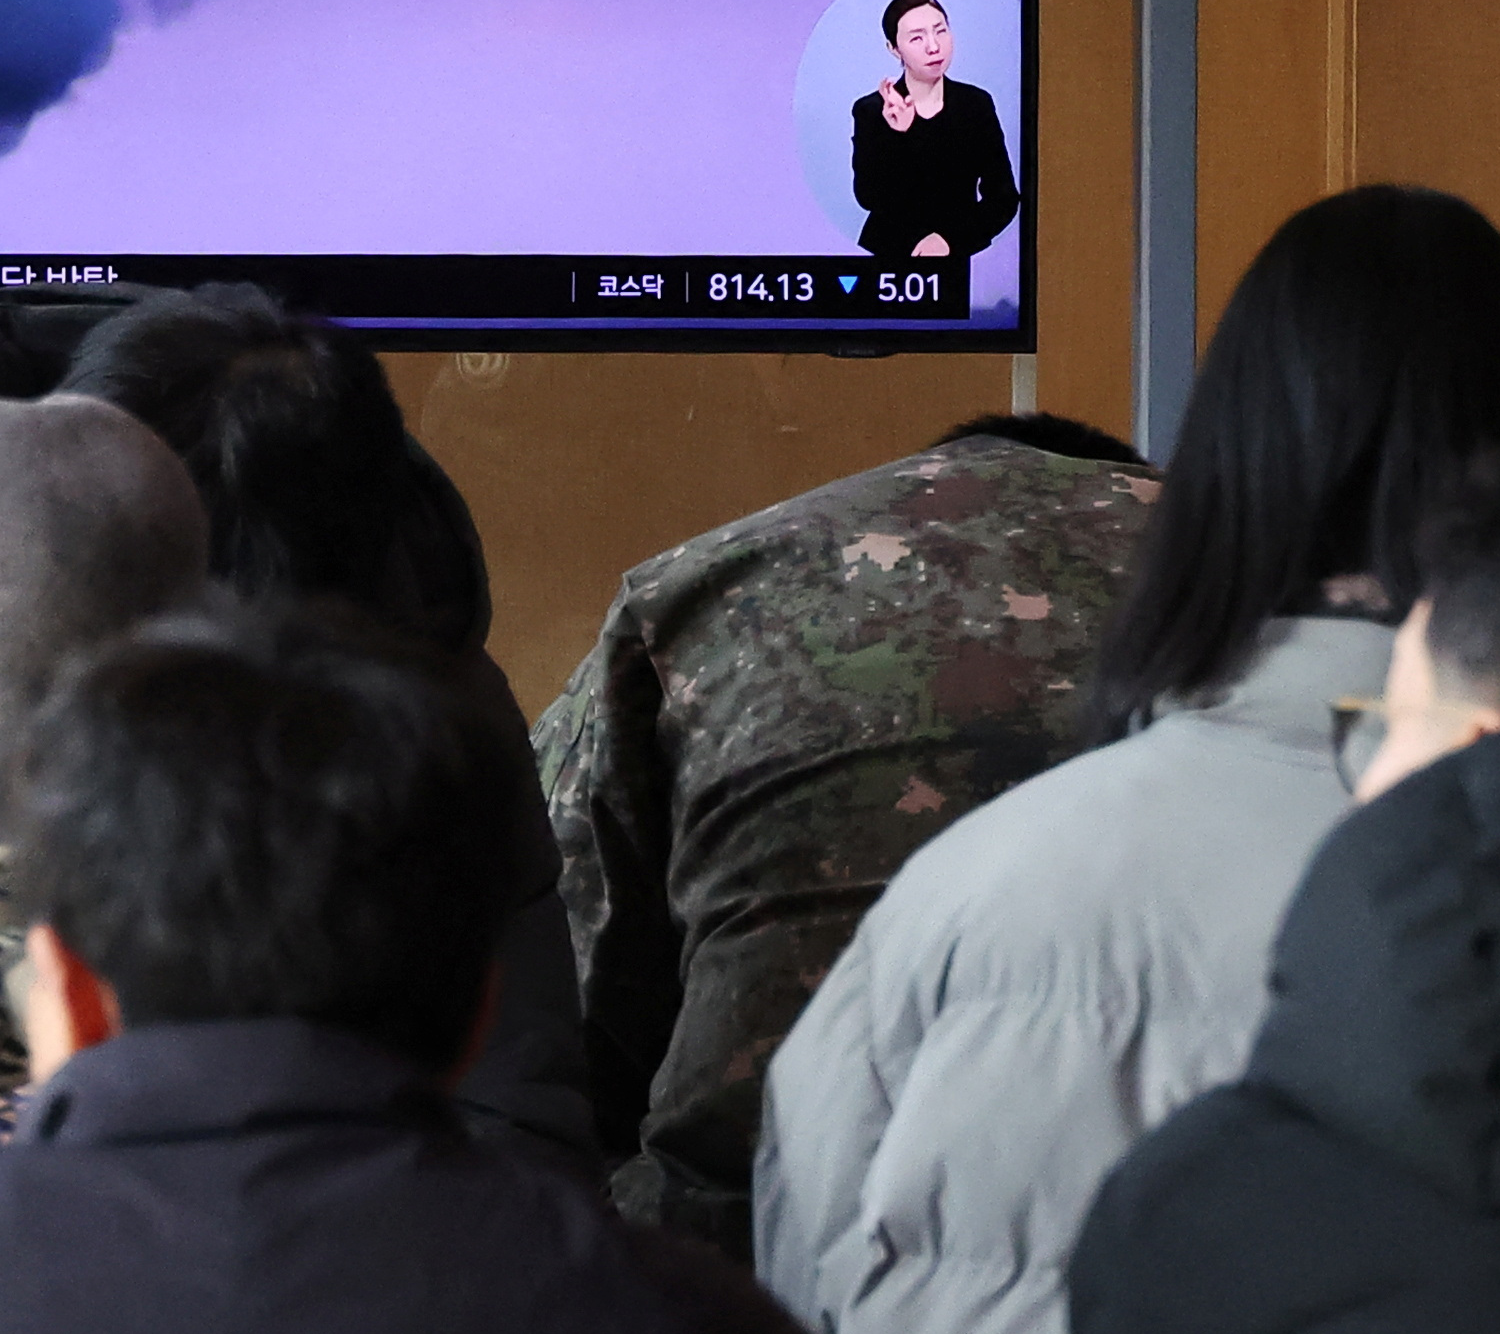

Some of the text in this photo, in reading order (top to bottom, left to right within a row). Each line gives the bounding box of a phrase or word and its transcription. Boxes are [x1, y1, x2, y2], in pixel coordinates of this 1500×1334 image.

[597, 273, 940, 302] 코스닥 814.13 5.01
